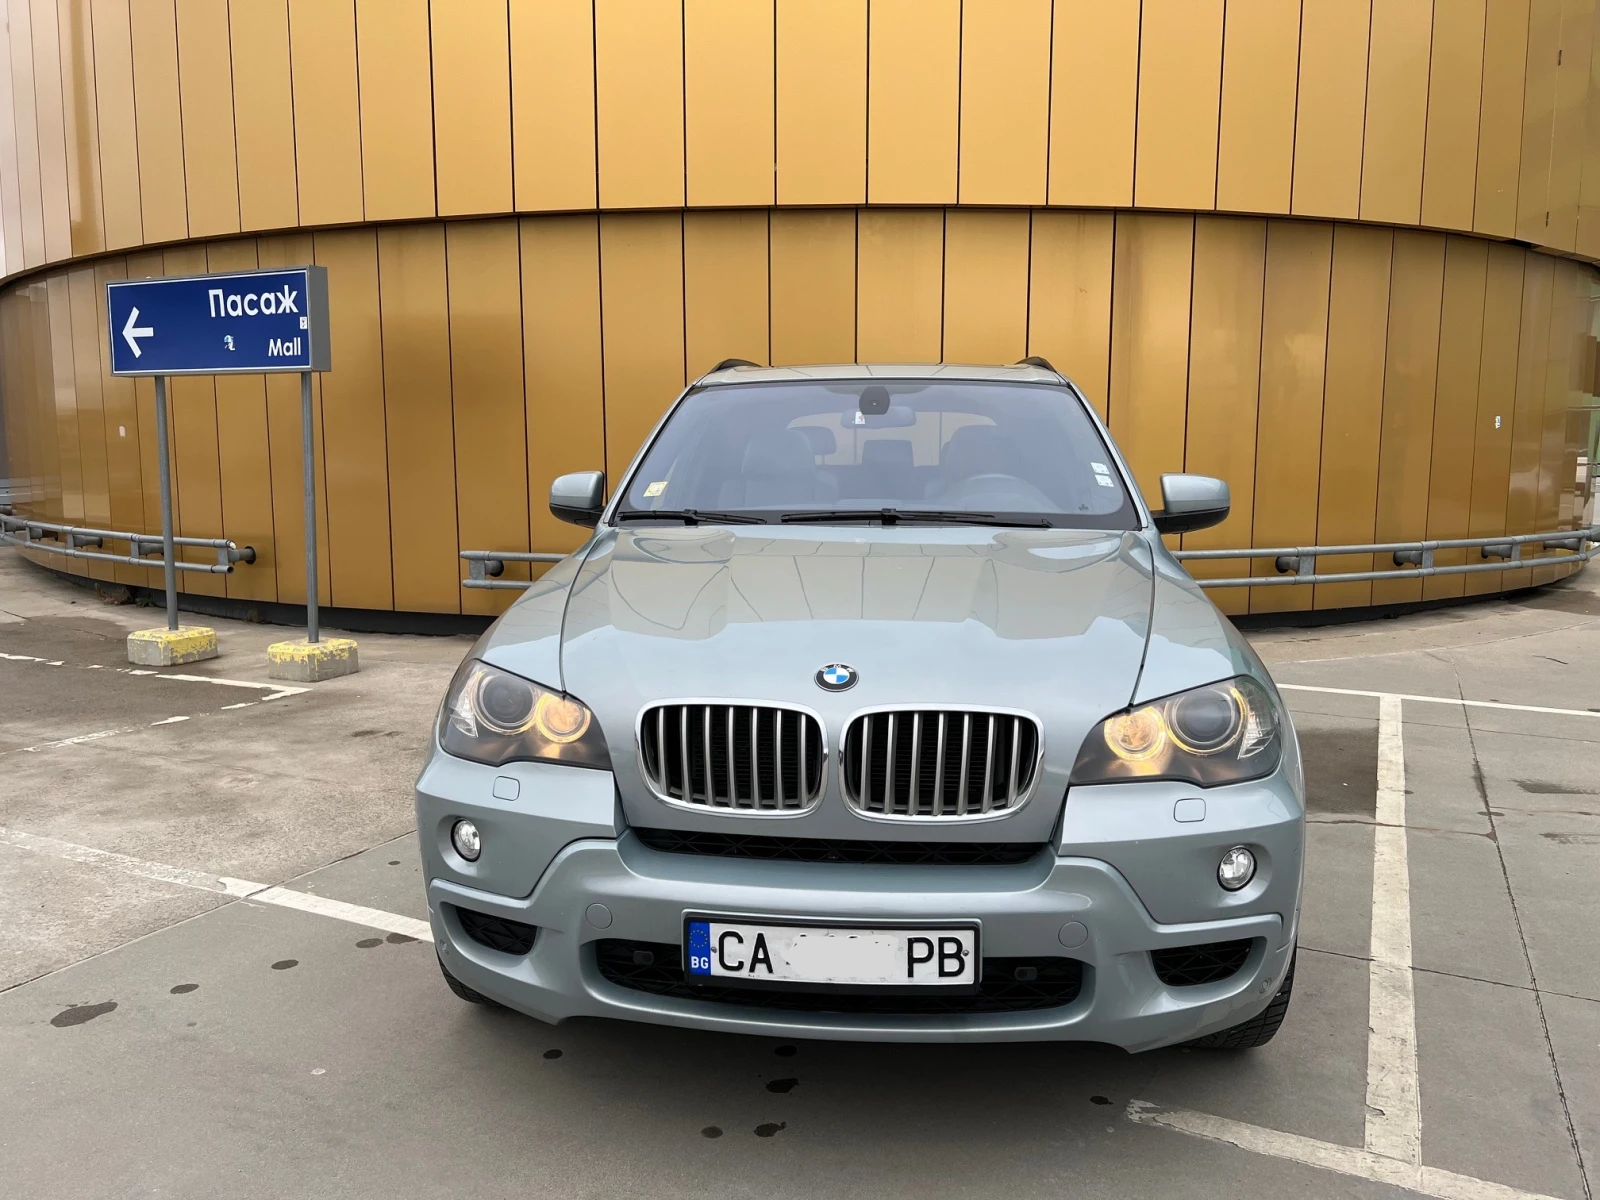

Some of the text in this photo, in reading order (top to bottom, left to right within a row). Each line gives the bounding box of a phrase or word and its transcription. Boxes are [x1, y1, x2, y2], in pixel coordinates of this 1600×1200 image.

[208, 285, 299, 318] Пасаж
[268, 337, 302, 357] Mall
[691, 956, 709, 969] BG
[718, 930, 774, 974] CA
[907, 936, 966, 978] PB
